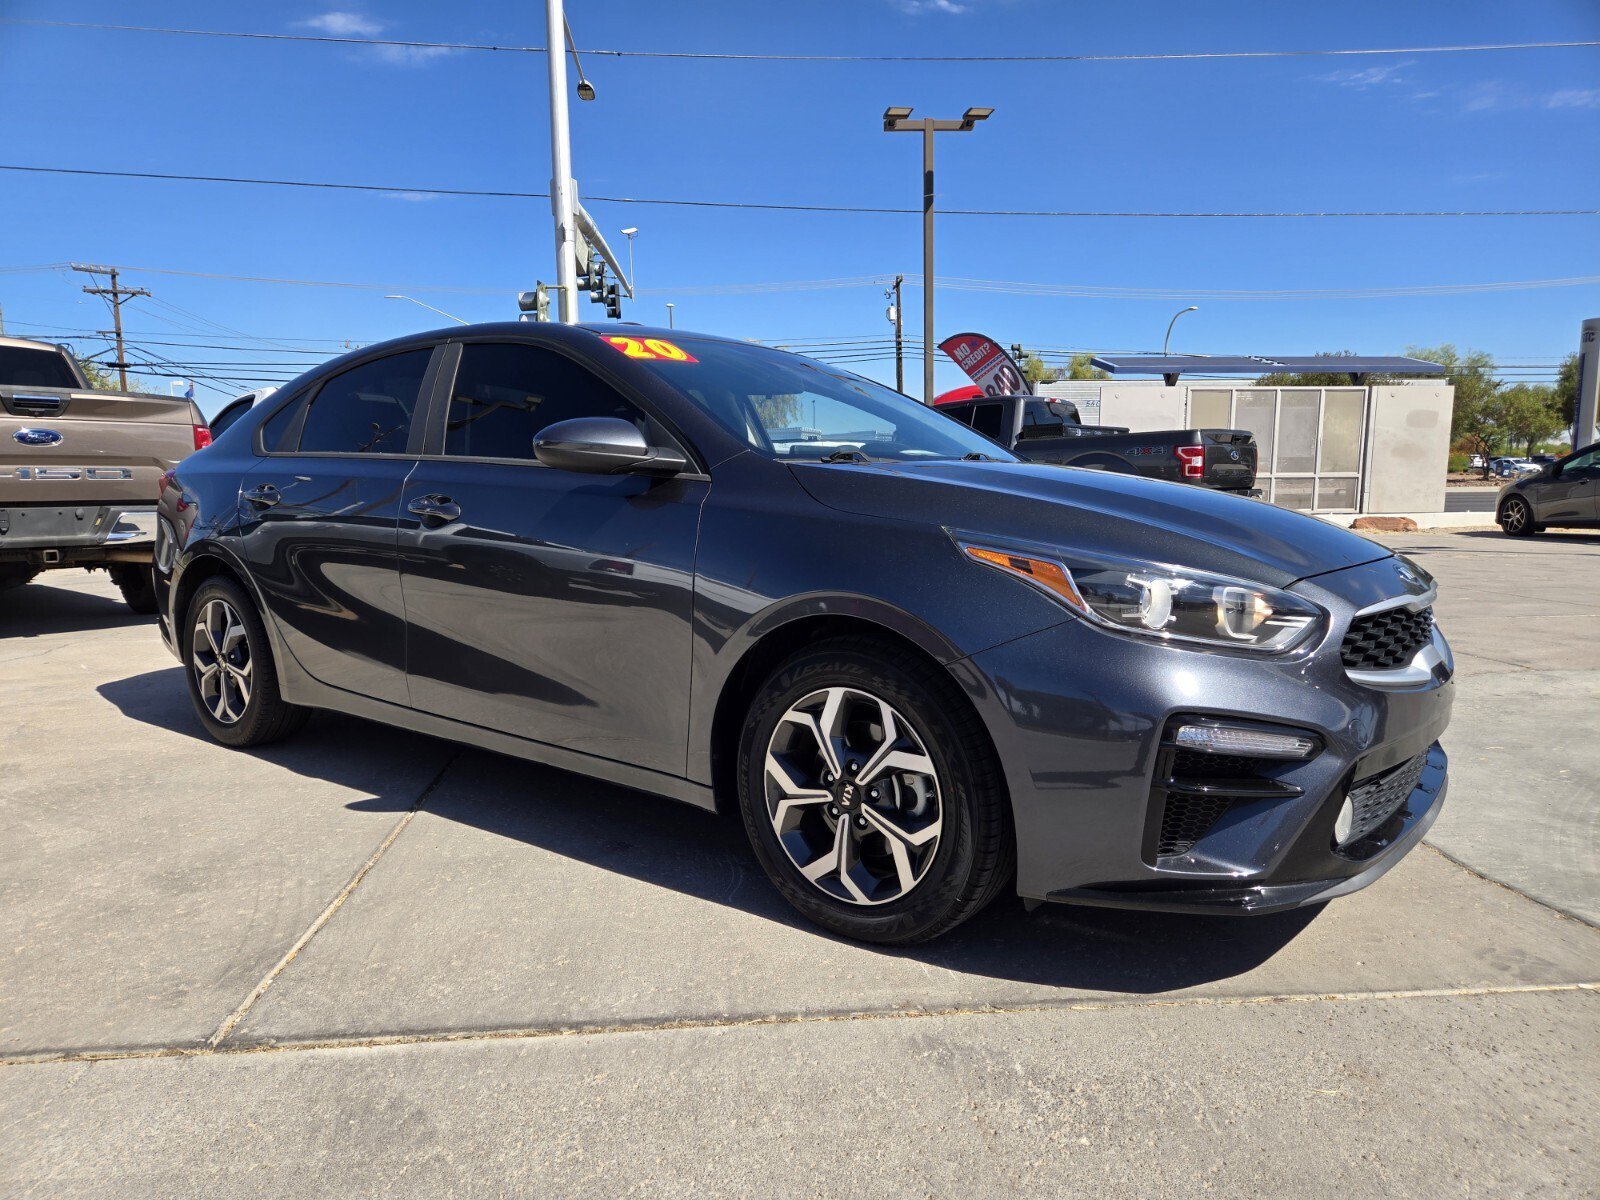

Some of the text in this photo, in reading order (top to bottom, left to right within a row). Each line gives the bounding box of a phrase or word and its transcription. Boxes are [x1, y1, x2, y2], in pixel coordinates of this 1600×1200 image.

[609, 336, 687, 361] 20
[953, 342, 971, 361] NO
[960, 342, 991, 371] CREDIT?
[841, 783, 855, 806] KIA
